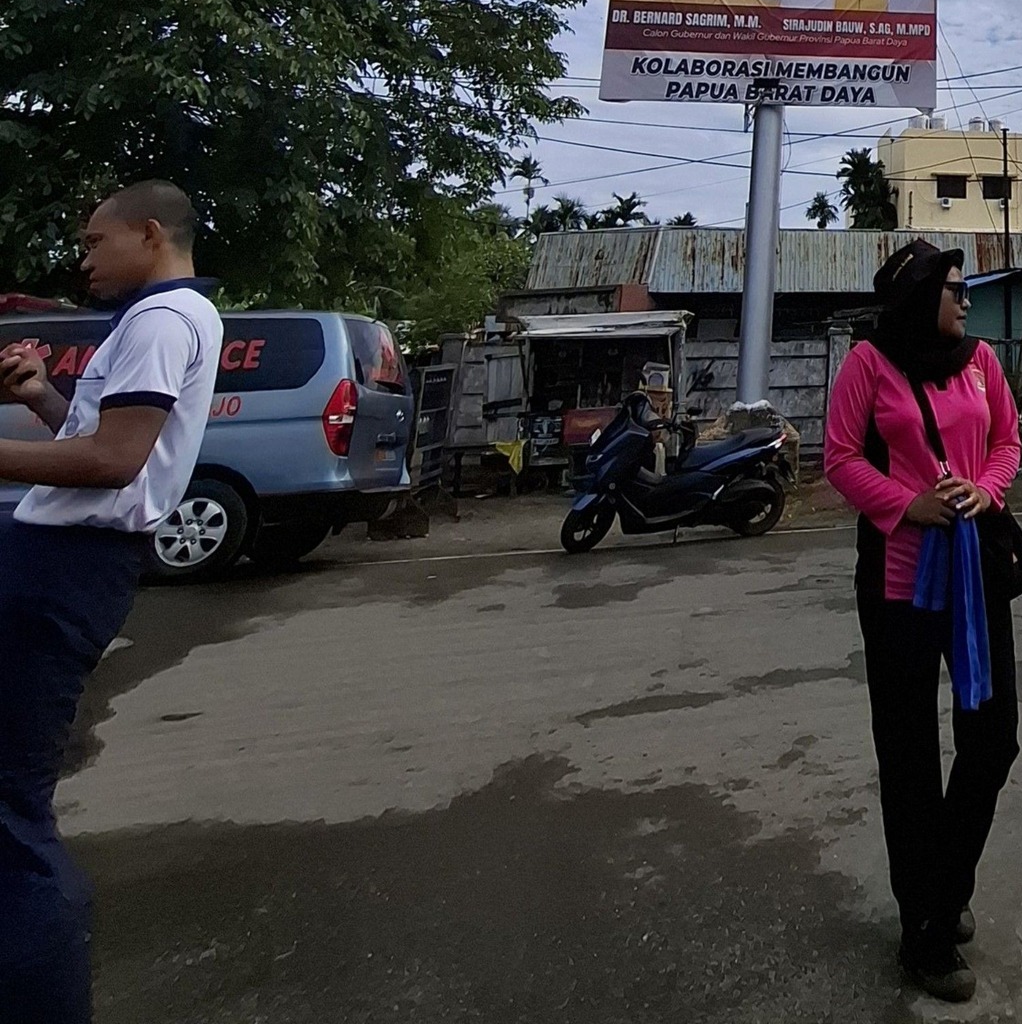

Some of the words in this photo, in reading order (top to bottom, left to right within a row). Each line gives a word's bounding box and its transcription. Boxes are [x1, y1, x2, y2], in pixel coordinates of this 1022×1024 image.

[611, 9, 630, 23] DR.
[633, 10, 683, 26] BERNARD
[733, 14, 762, 29] M.M.
[782, 18, 833, 33] SIRAJUDIN
[896, 23, 931, 37] M.MPD
[642, 28, 669, 37] Calon
[670, 29, 713, 40] Gubernur
[714, 31, 731, 40] dan
[732, 31, 756, 41] Wakil
[756, 33, 799, 43] Gubernur
[799, 34, 833, 44] Provinsi
[833, 36, 861, 46] Papua
[862, 37, 885, 46] Barat
[886, 37, 908, 48] Daya
[631, 56, 770, 78] KOLABORASI
[775, 61, 911, 82] MEMBANGUN
[664, 80, 739, 99] PAPUA
[820, 85, 876, 104] DAYA
